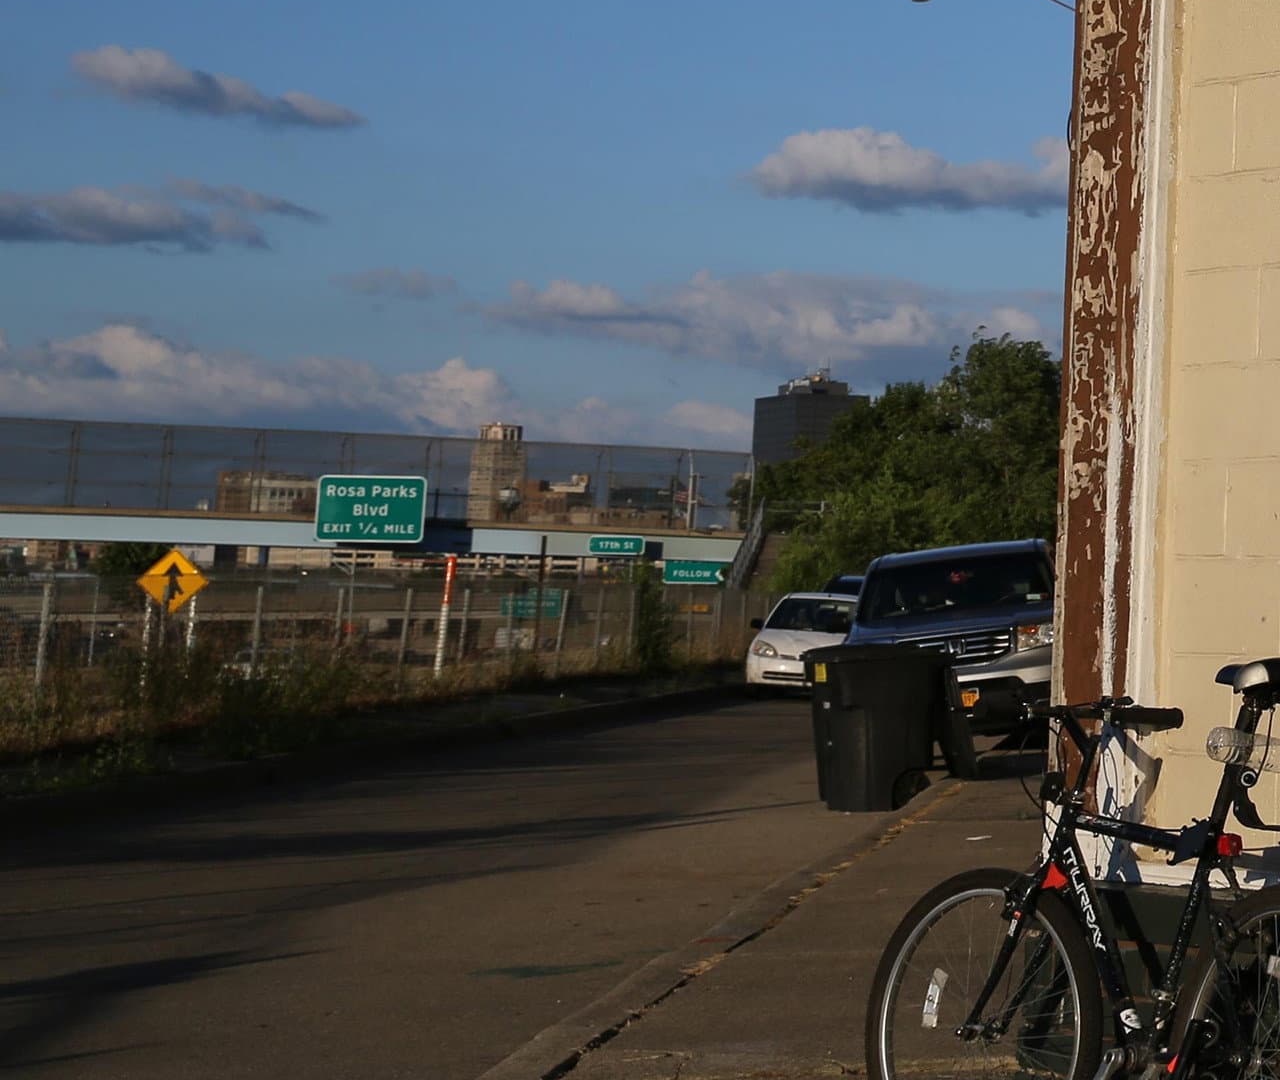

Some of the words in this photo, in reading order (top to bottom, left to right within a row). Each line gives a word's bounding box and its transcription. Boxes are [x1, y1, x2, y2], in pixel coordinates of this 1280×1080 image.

[326, 484, 366, 497] Rosa
[371, 485, 417, 498] Parks
[352, 503, 389, 517] Blvd
[323, 523, 352, 533] EXIT
[383, 524, 415, 534] MILE
[599, 541, 621, 549] 17th
[672, 569, 711, 577] FOLLOW
[1062, 846, 1107, 952] MURRAY
